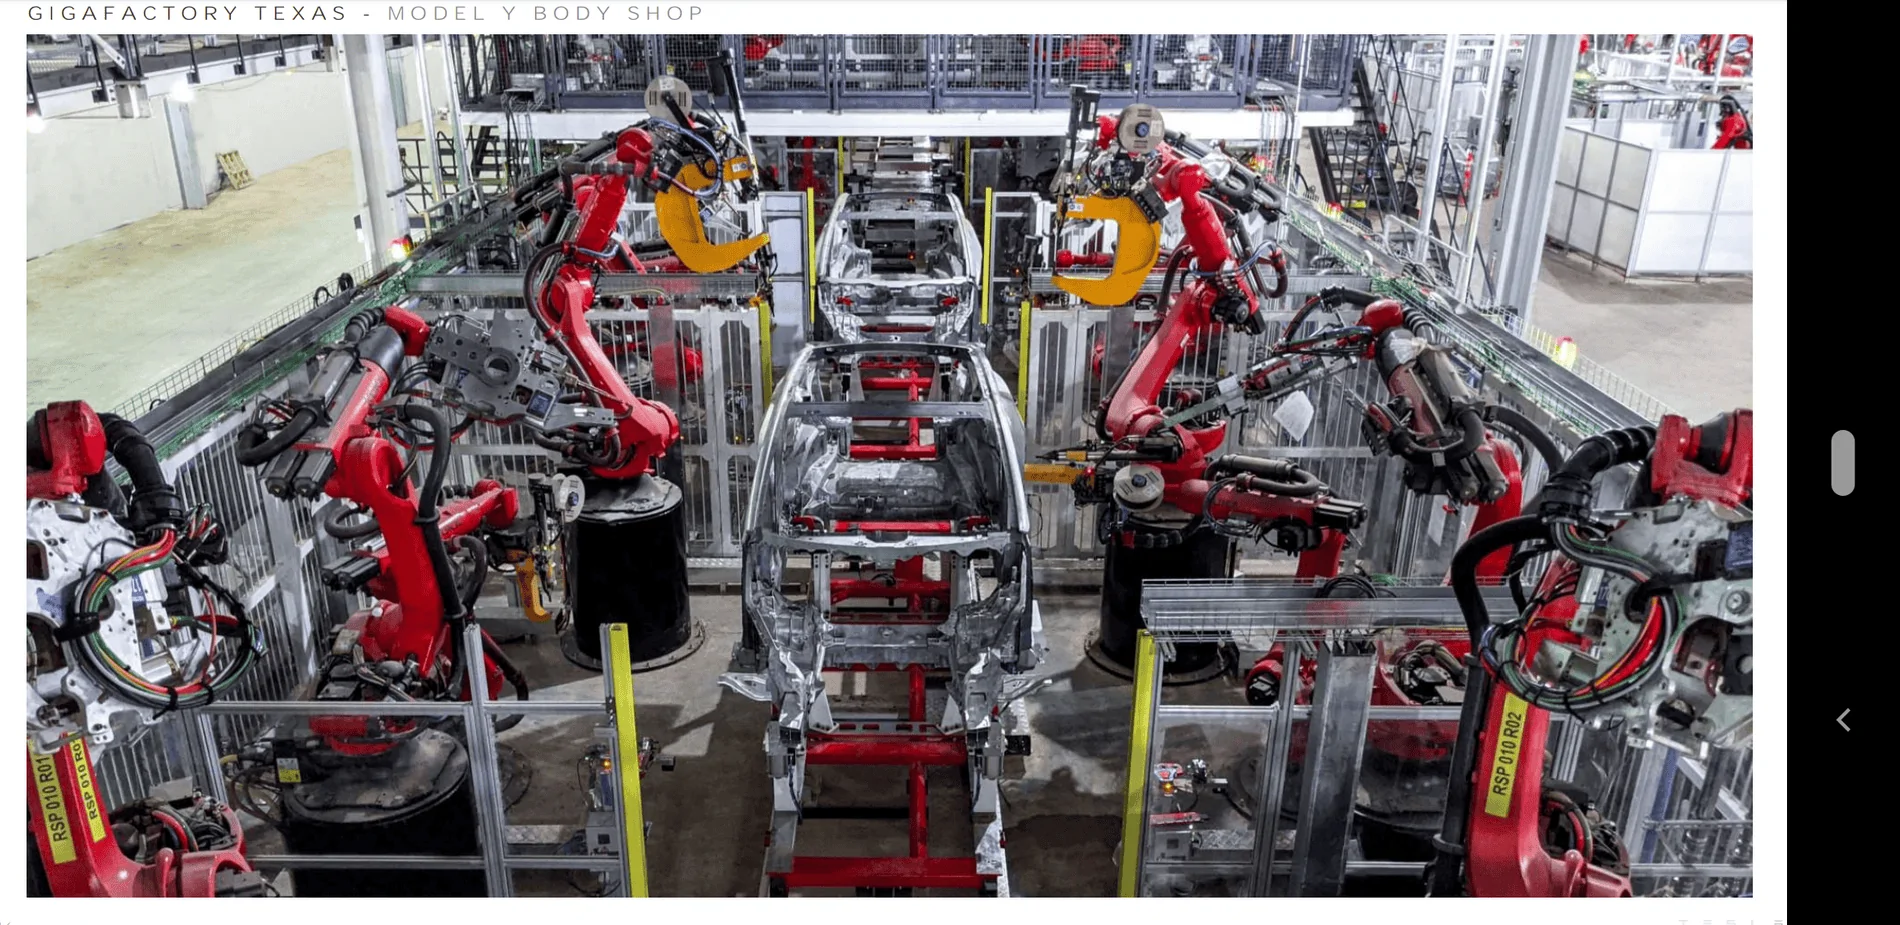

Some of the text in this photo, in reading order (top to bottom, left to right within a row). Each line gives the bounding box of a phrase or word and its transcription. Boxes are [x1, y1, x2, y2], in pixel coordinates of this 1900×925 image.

[78, 765, 90, 788] 010
[1493, 712, 1522, 795] RSP 010 R02
[36, 757, 67, 841] RSP 010 R01
[84, 792, 98, 819] RSP
